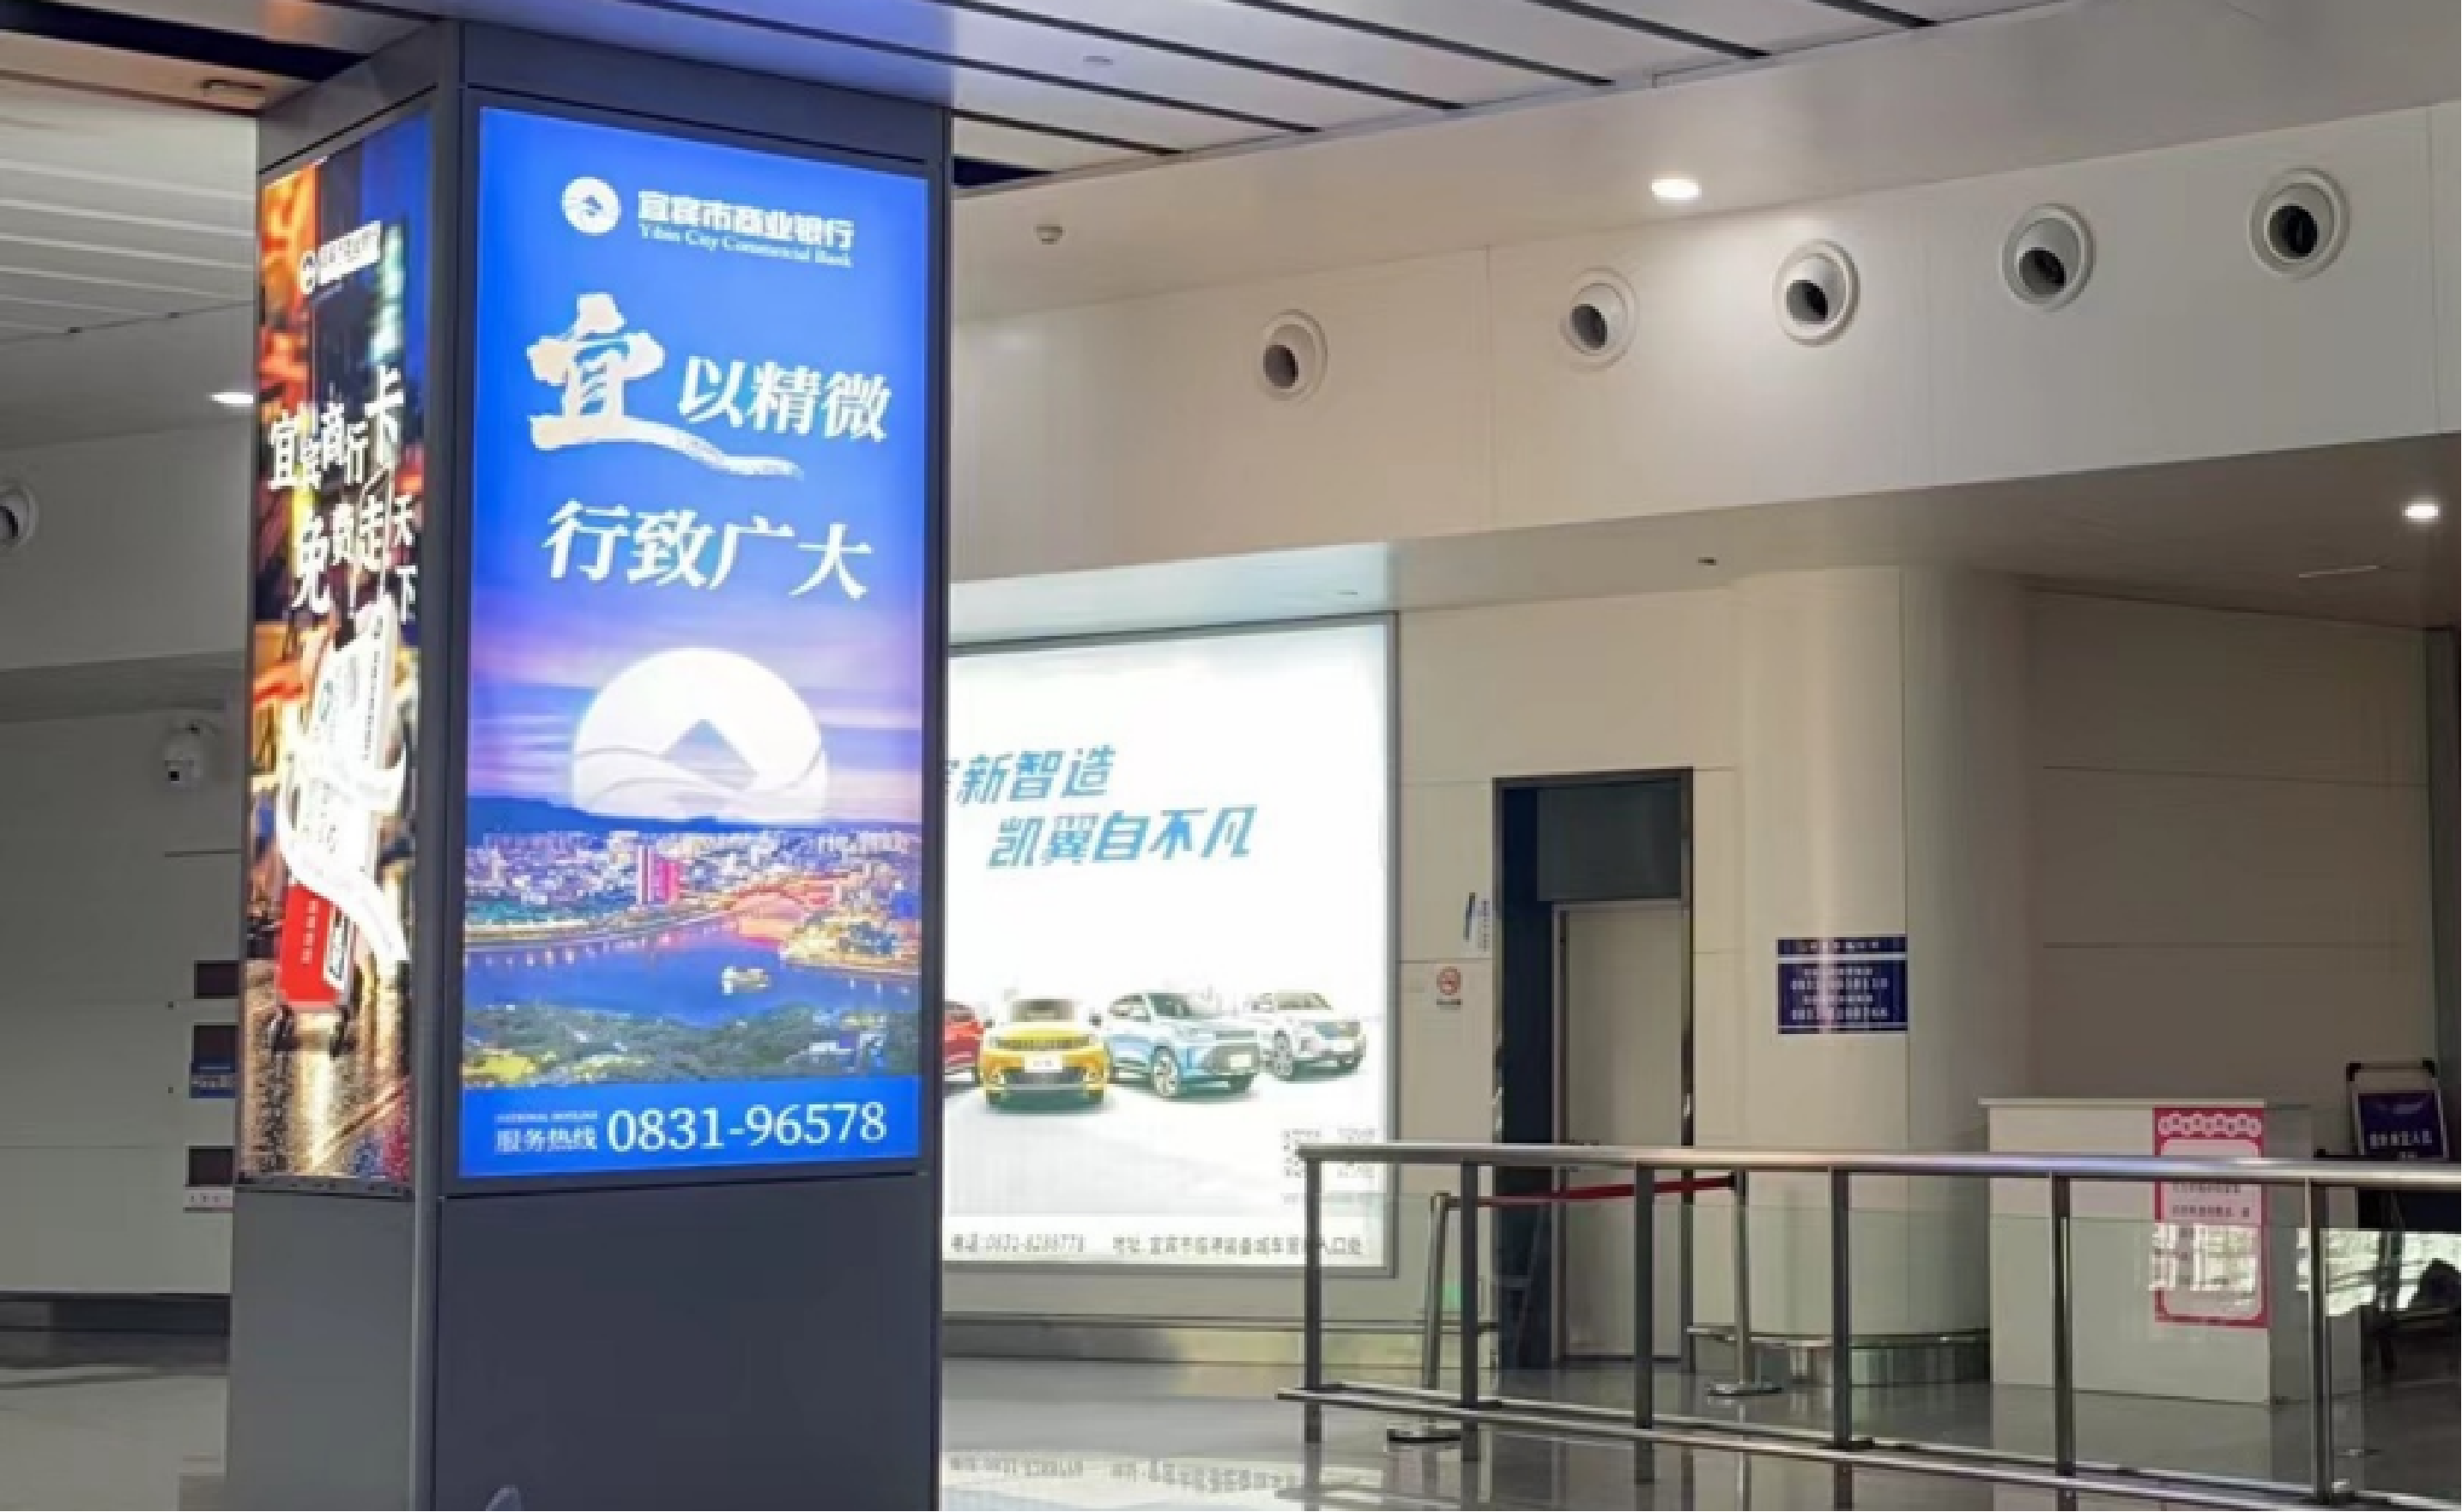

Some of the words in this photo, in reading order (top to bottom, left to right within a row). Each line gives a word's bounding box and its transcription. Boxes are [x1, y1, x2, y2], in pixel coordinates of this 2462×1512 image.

[638, 188, 855, 250] 宜宾市商业银行
[638, 223, 681, 243] Yibin
[686, 229, 719, 253] City
[723, 237, 810, 263] Commercial
[814, 249, 855, 269] Bank
[541, 498, 874, 600] 行致广大
[948, 744, 1117, 807] 新智造
[987, 804, 1259, 870] 凯翼自不凡
[494, 1124, 598, 1153] 服务热线
[606, 1101, 888, 1153] 0831-96578
